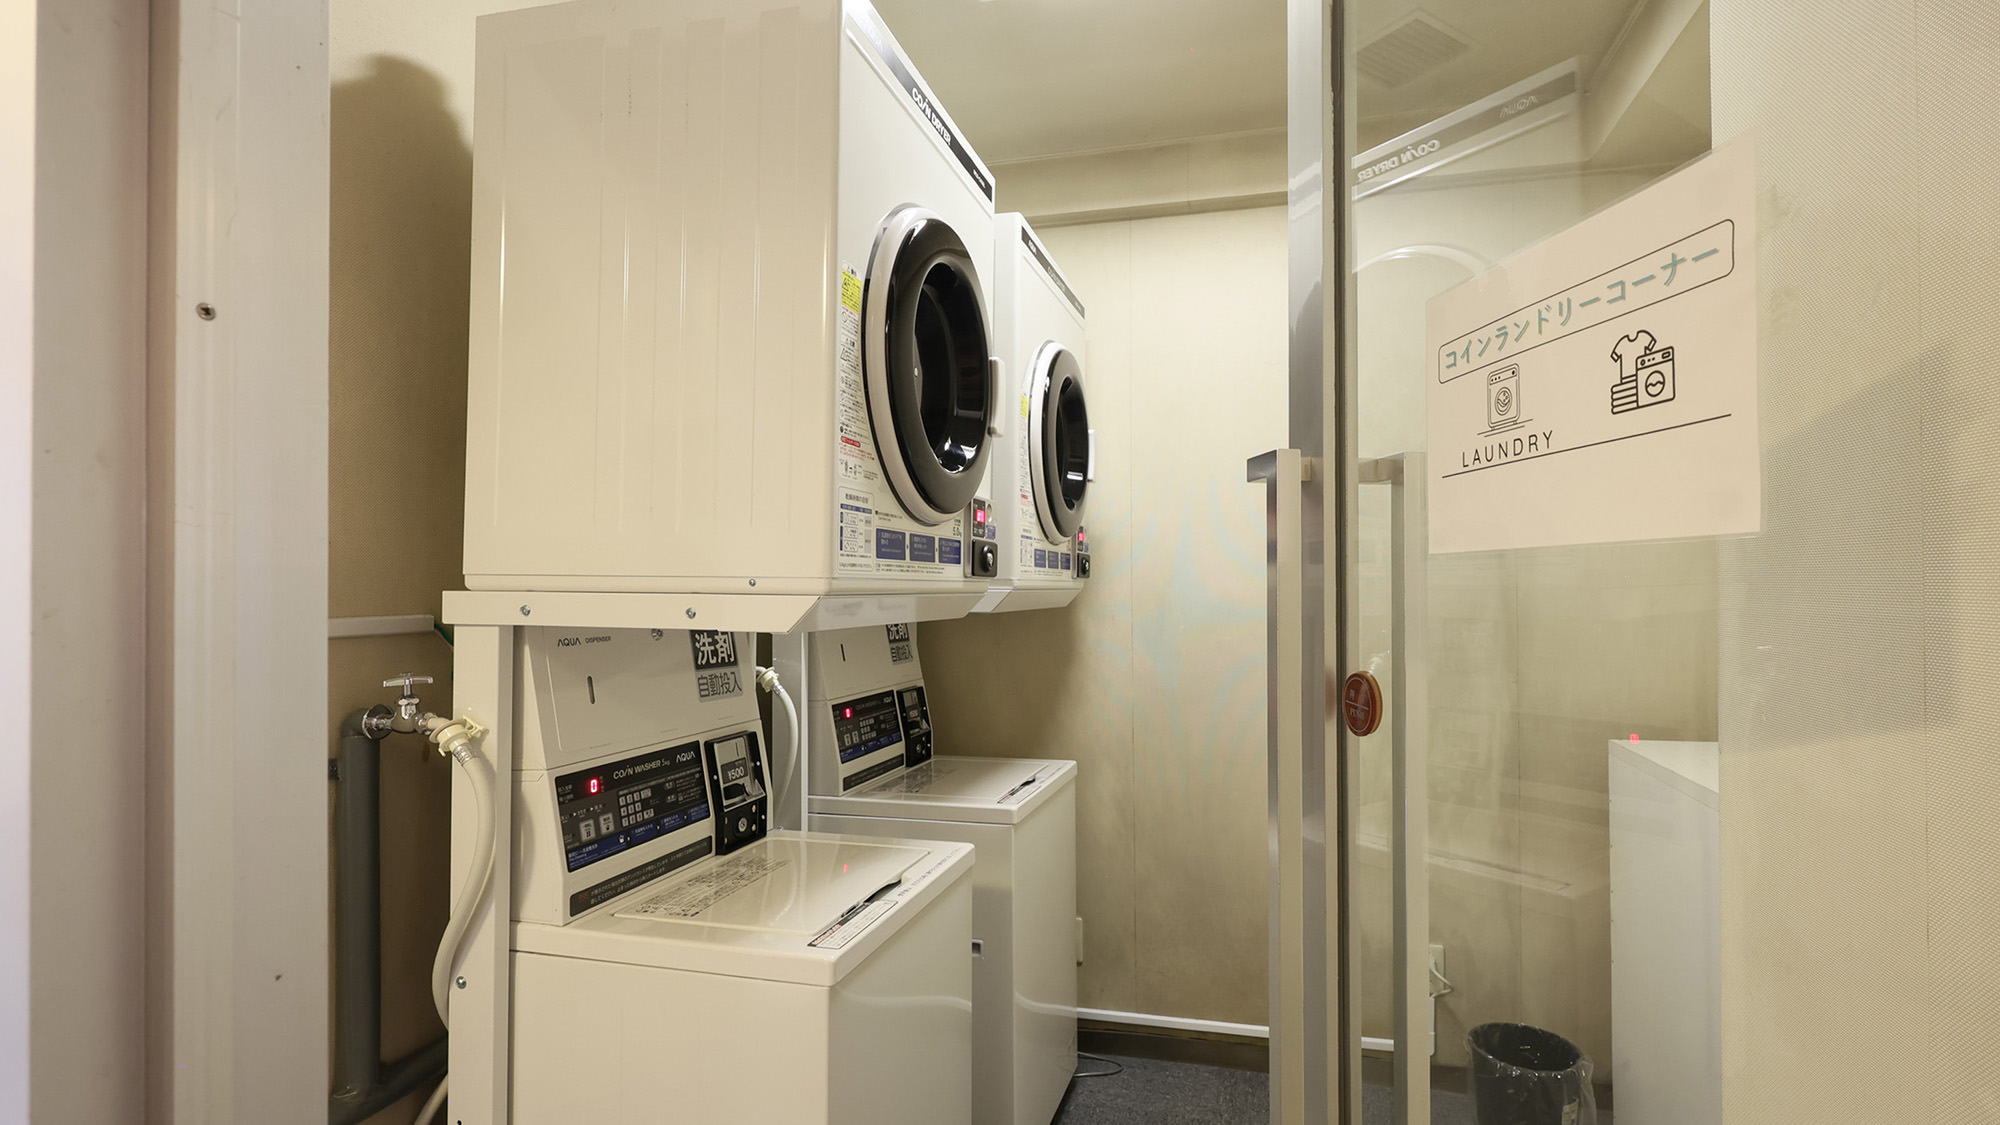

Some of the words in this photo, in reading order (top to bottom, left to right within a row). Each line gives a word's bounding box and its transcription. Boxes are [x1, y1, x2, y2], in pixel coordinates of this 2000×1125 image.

[912, 87, 932, 120] COIN
[931, 111, 951, 146] DRYER
[1445, 247, 1720, 370] コインランドリーコーナー
[1461, 429, 1554, 469] LAUNDRY
[557, 637, 581, 648] AQUA
[695, 631, 735, 666] 洗剤
[697, 671, 742, 698] 自動投入
[613, 764, 634, 780] COIN
[634, 759, 662, 775] WASHER
[676, 751, 696, 763] AQUA
[727, 766, 745, 781] ¥500
[590, 779, 598, 793] 0
